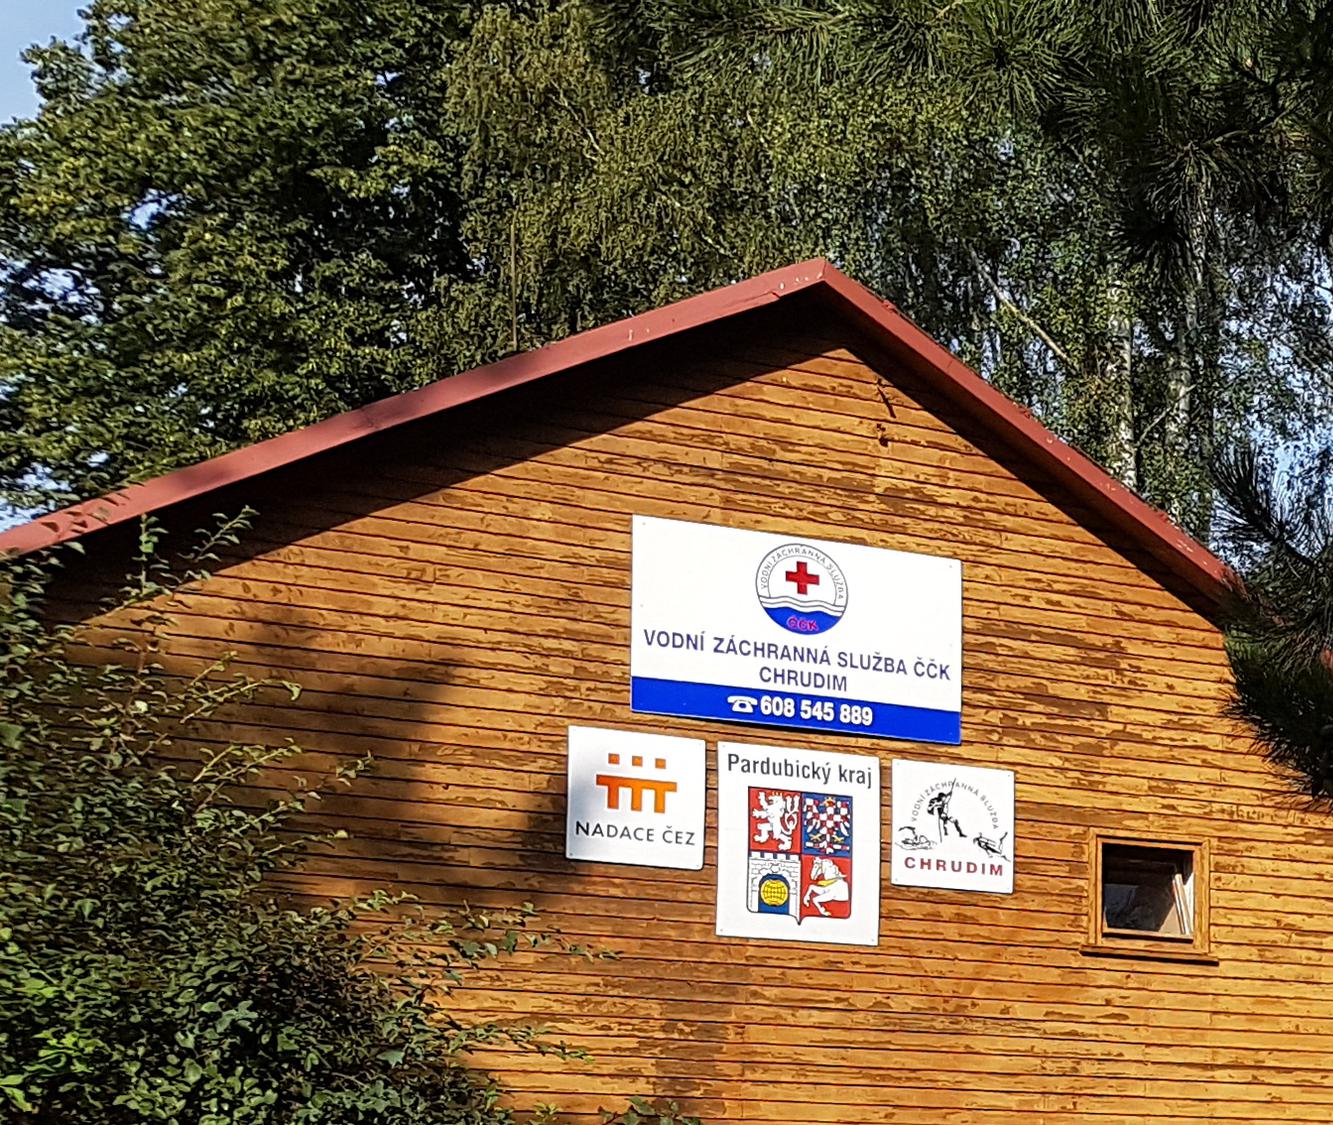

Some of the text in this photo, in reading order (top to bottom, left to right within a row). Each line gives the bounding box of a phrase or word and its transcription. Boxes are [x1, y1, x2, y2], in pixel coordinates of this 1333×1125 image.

[644, 628, 951, 681] VODNÍ ZÁCHRANNÁ SLUŽBA ČČK
[759, 666, 848, 692] CHRUDIM
[760, 696, 873, 726] 608 545 889
[727, 753, 872, 789] Pardubický kraj
[576, 820, 696, 846] NADACE ČEZ
[904, 856, 1003, 877] CHRUDIM
